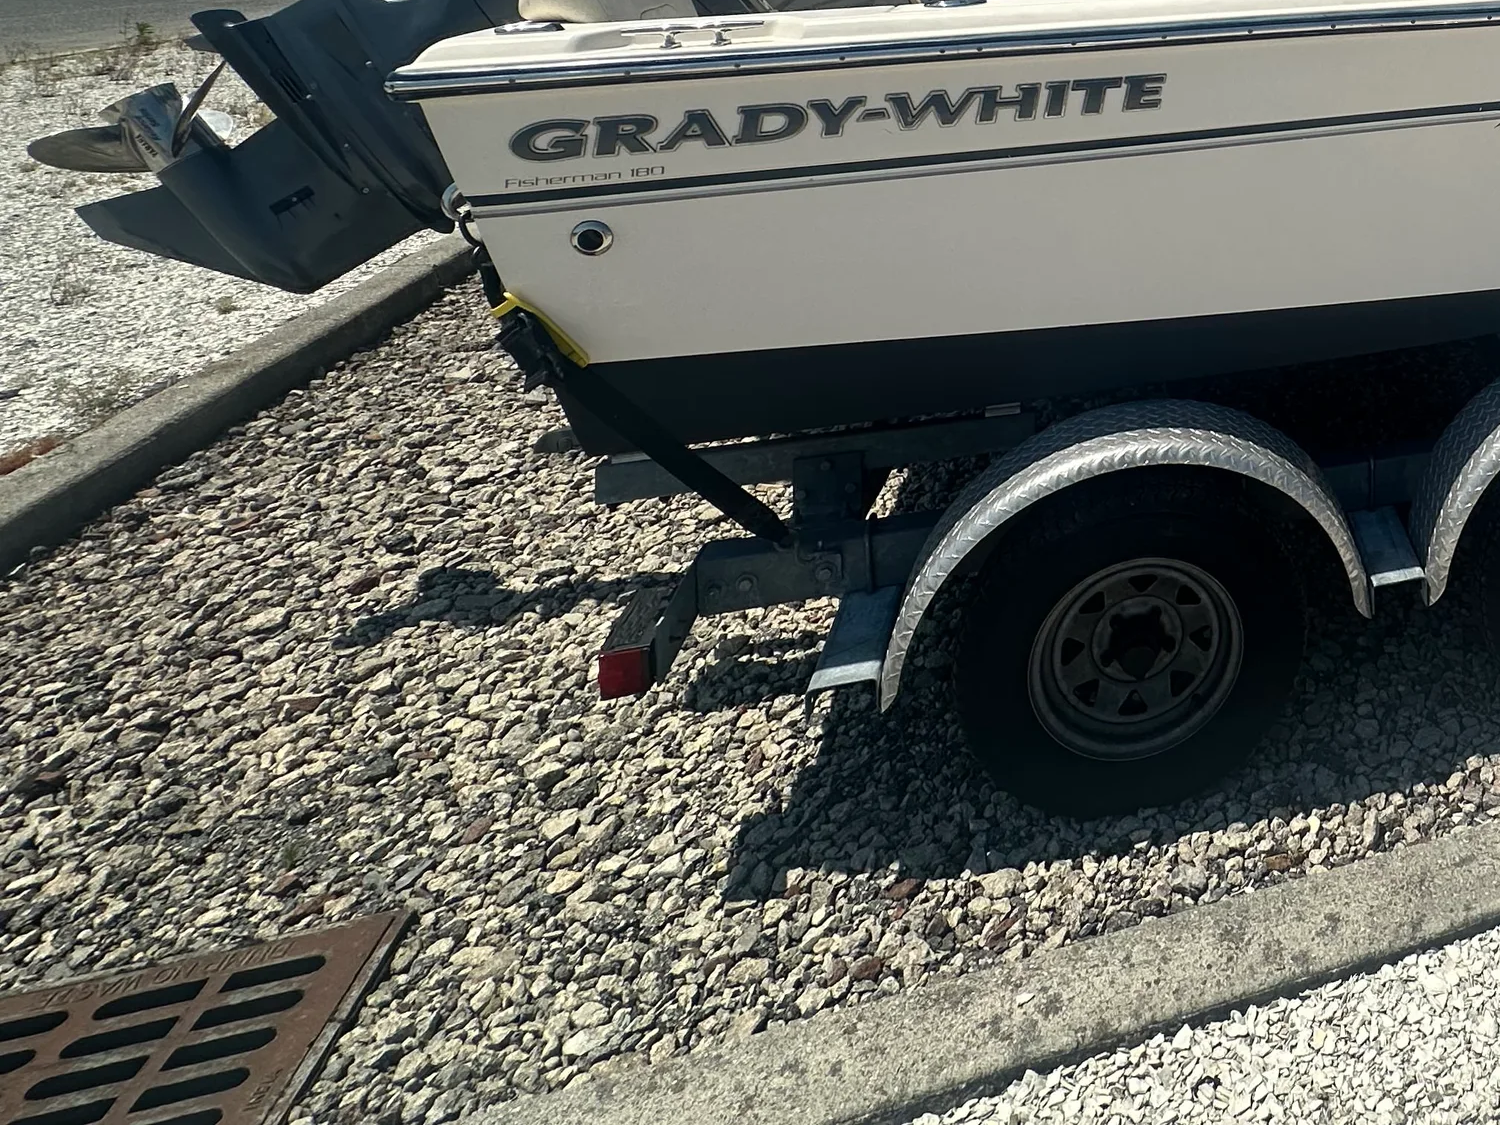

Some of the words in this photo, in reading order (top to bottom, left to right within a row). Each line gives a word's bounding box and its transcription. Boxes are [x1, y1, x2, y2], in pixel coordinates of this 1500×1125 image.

[508, 73, 1168, 163] GRADY-WHITE
[504, 171, 621, 189] Fisherman
[630, 165, 665, 177] 180
[203, 941, 297, 972] DUMP
[154, 962, 199, 984] NO
